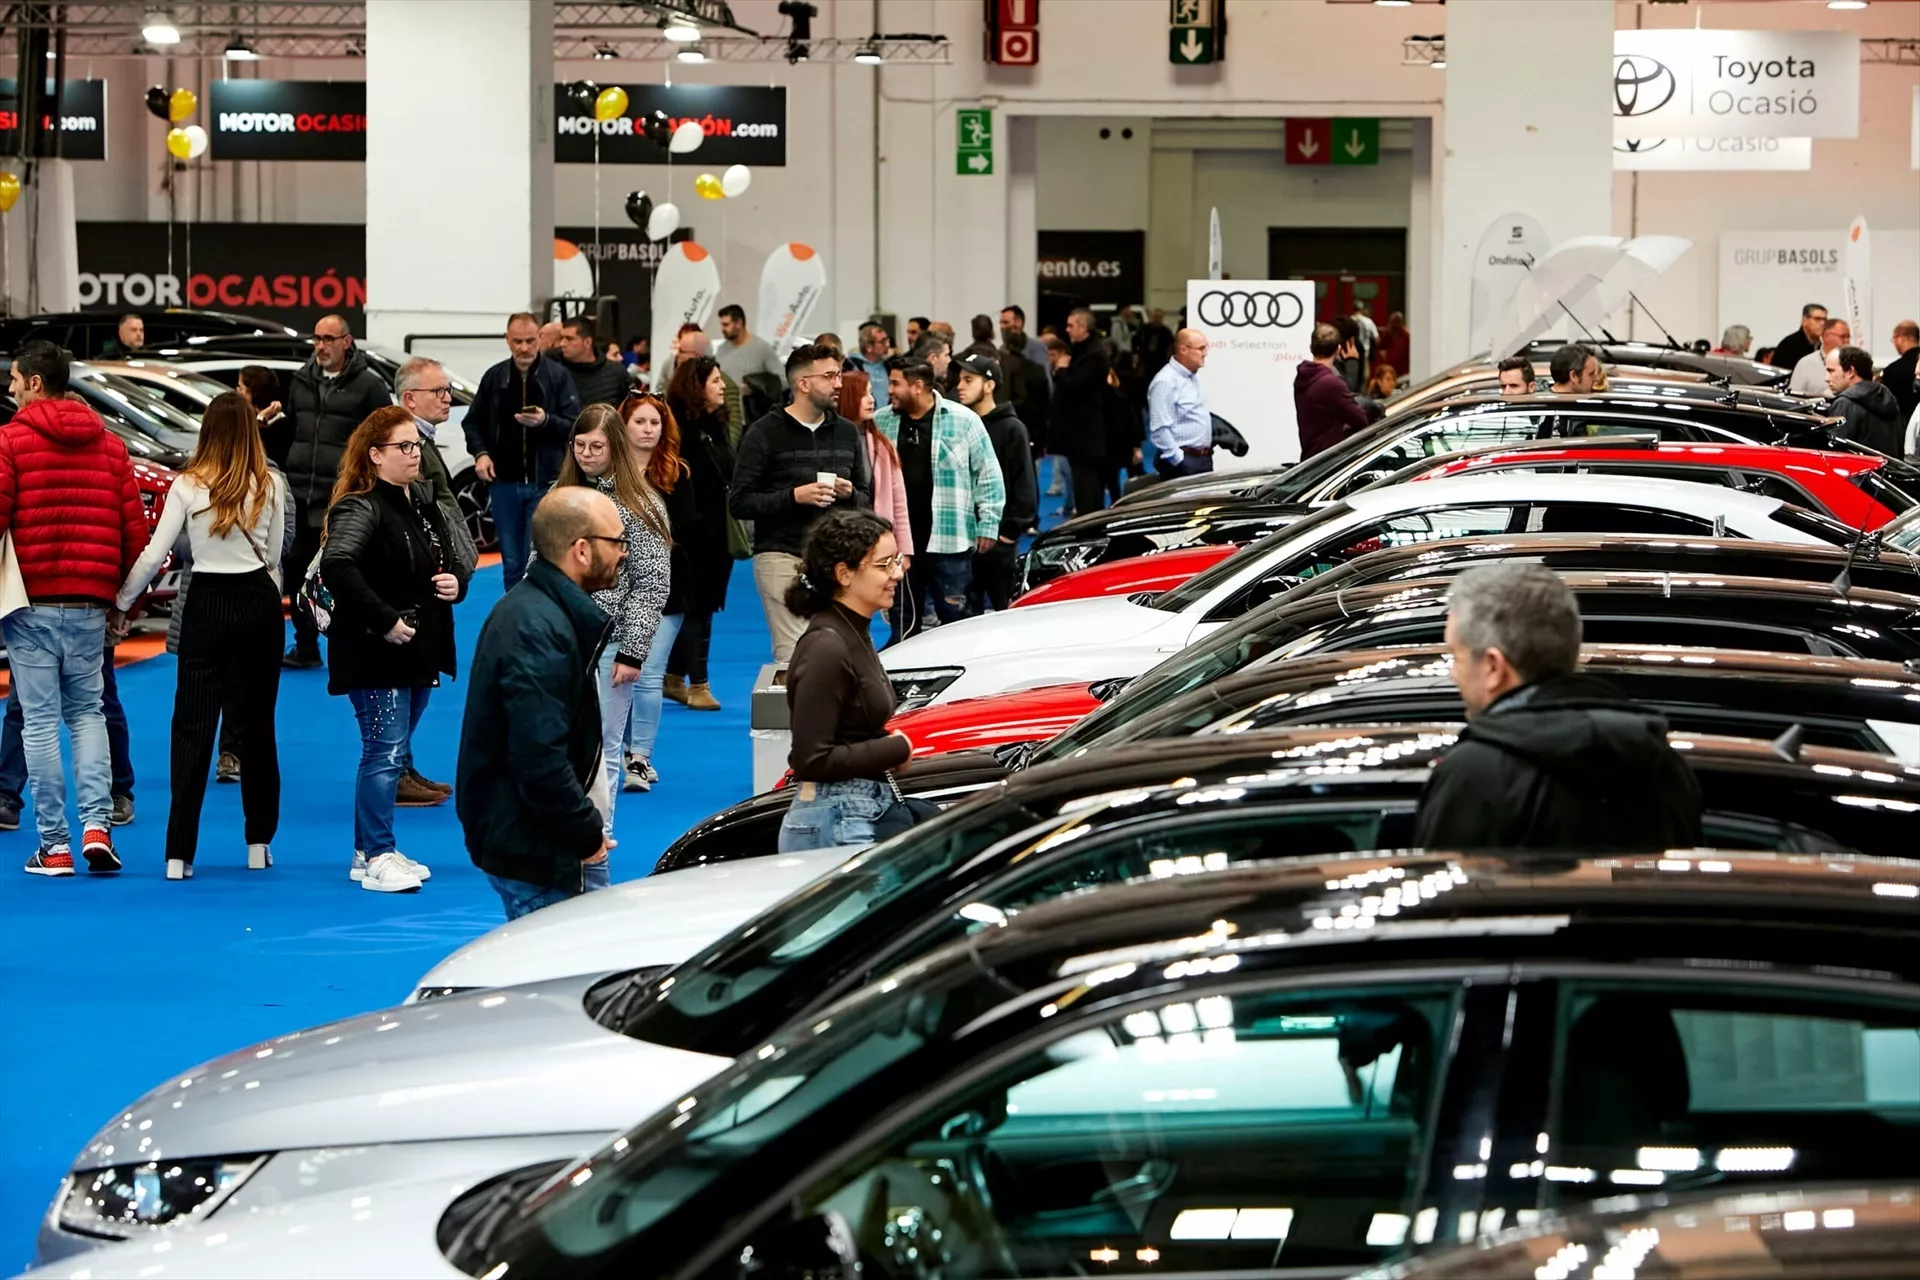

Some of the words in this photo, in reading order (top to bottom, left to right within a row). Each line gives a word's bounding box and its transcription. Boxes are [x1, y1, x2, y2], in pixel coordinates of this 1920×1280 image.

[1713, 54, 1816, 85] Toyota
[1708, 89, 1818, 116] Ocasió
[1037, 257, 1121, 278] ento.es
[1206, 340, 1227, 349] udi
[1230, 340, 1288, 350] Selection
